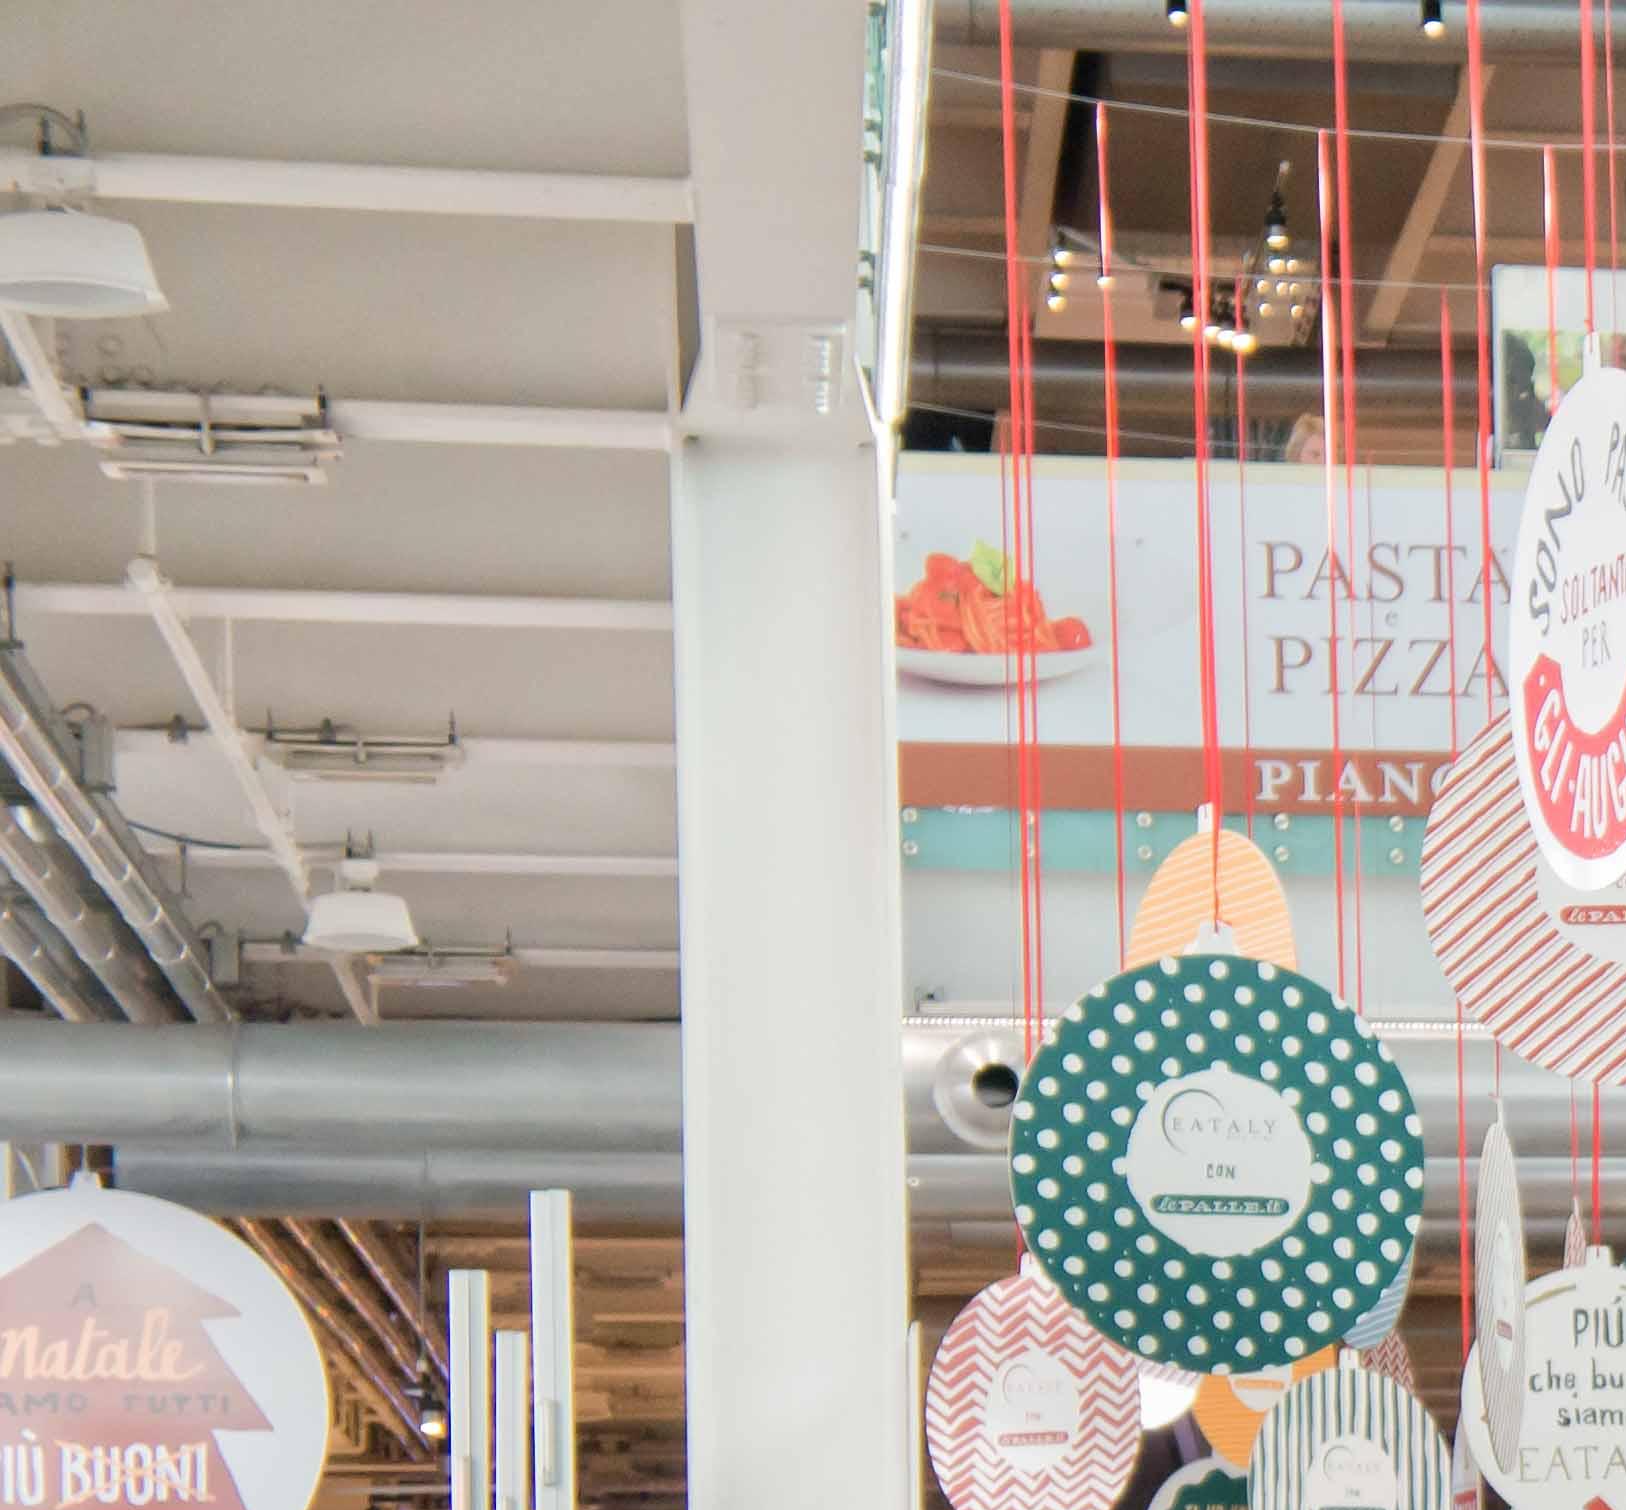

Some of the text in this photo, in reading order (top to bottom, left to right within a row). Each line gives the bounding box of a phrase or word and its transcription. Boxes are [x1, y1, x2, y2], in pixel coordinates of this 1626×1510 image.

[1528, 436, 1586, 637] SONO
[1257, 541, 1512, 604] PASTA
[1266, 636, 1512, 698] PIZZA
[1581, 621, 1611, 669] PER
[1172, 1117, 1277, 1135] EATALY
[1206, 1163, 1236, 1180] CON
[123, 1391, 232, 1414] TUTTI
[58, 1439, 213, 1506] BUONI
